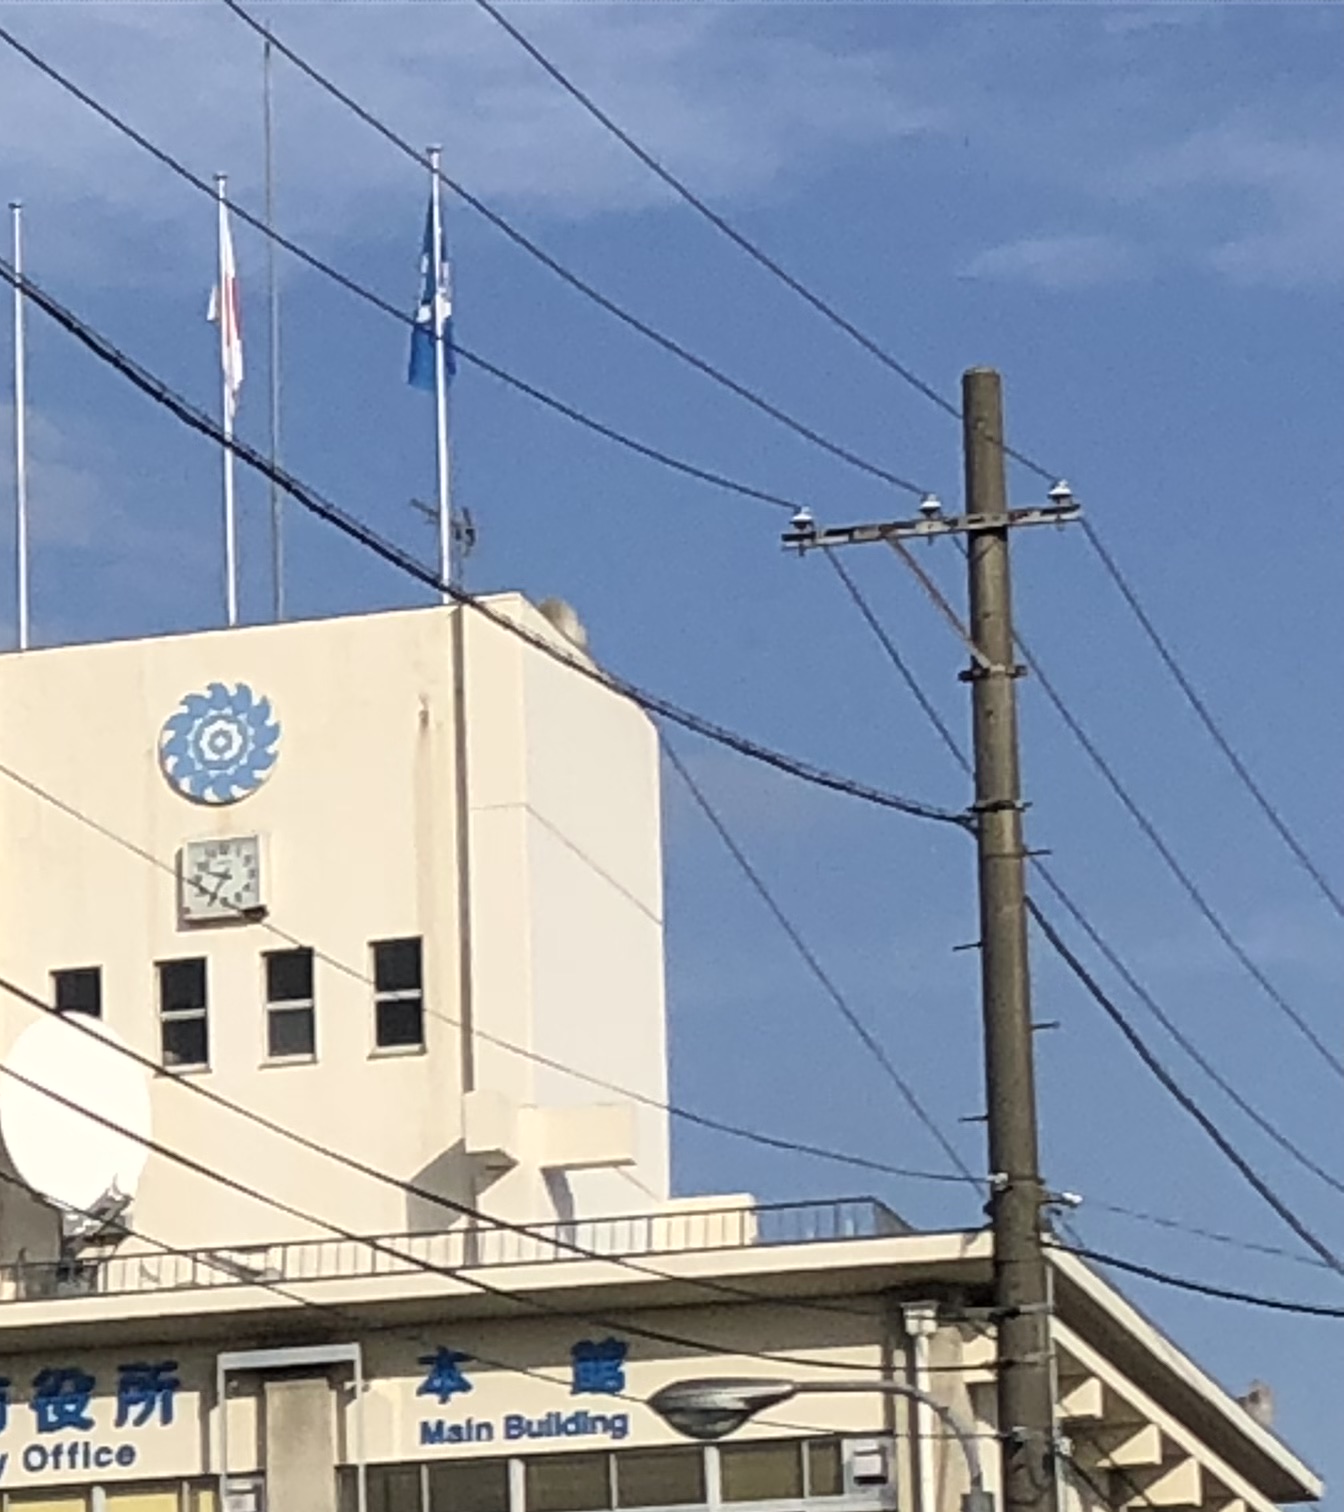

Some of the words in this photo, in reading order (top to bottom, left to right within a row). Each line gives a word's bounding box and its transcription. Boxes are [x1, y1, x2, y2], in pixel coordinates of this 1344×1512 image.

[420, 1419, 494, 1445] Main
[503, 1411, 628, 1440] Building
[23, 1442, 137, 1473] Office
